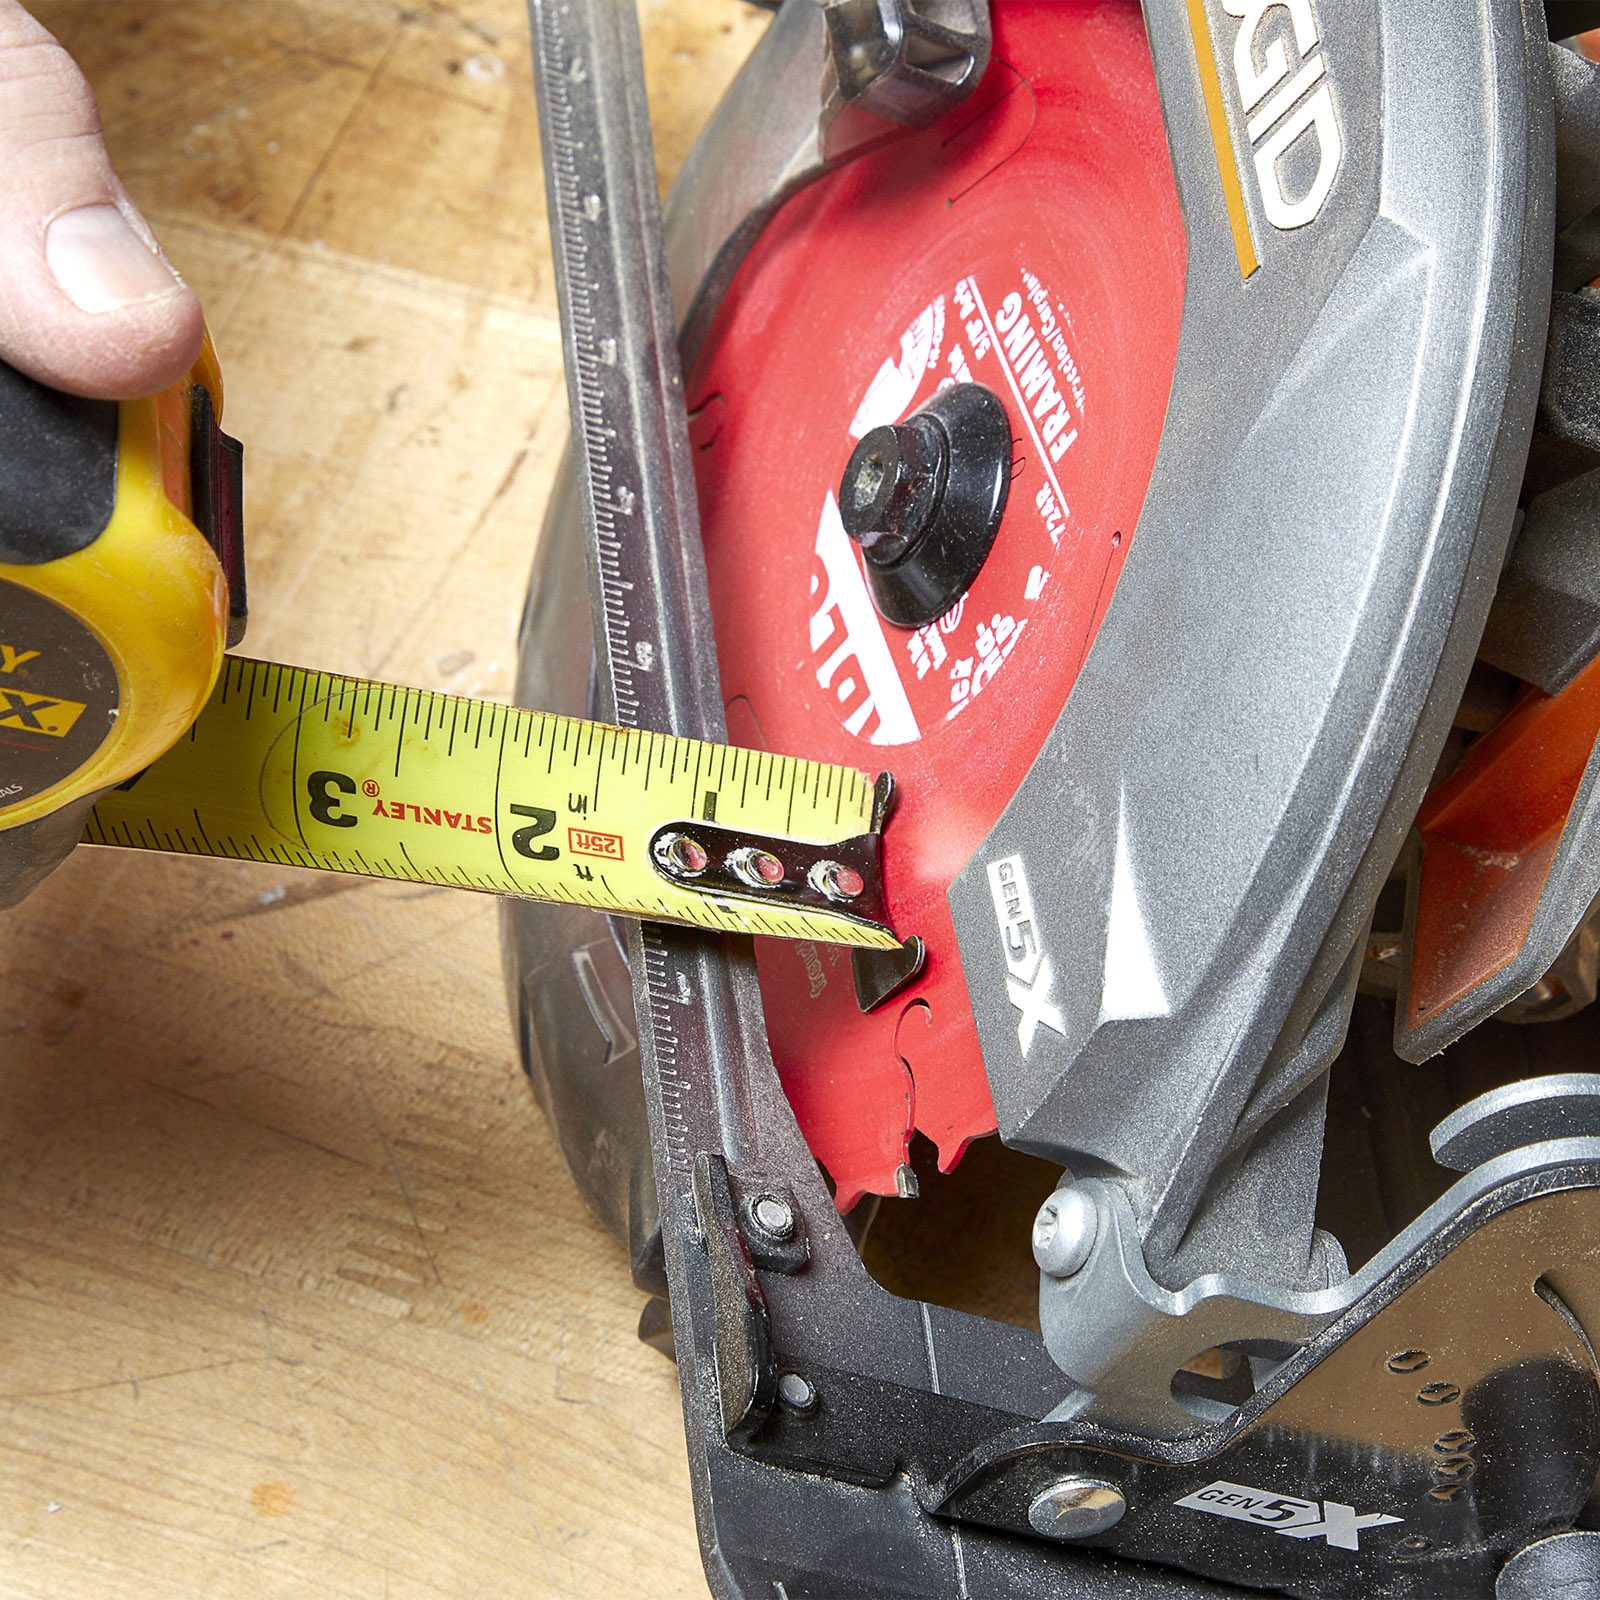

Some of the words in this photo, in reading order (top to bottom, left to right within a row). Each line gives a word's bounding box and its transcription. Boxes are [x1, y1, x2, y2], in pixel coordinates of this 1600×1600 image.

[1222, 0, 1342, 230] GID
[996, 292, 1078, 463] FRAMING
[307, 770, 358, 828] 3
[371, 799, 493, 834] STANLEY
[567, 792, 588, 820] in
[508, 802, 560, 861] 2
[576, 832, 616, 855] 25ft
[572, 863, 595, 882] ft
